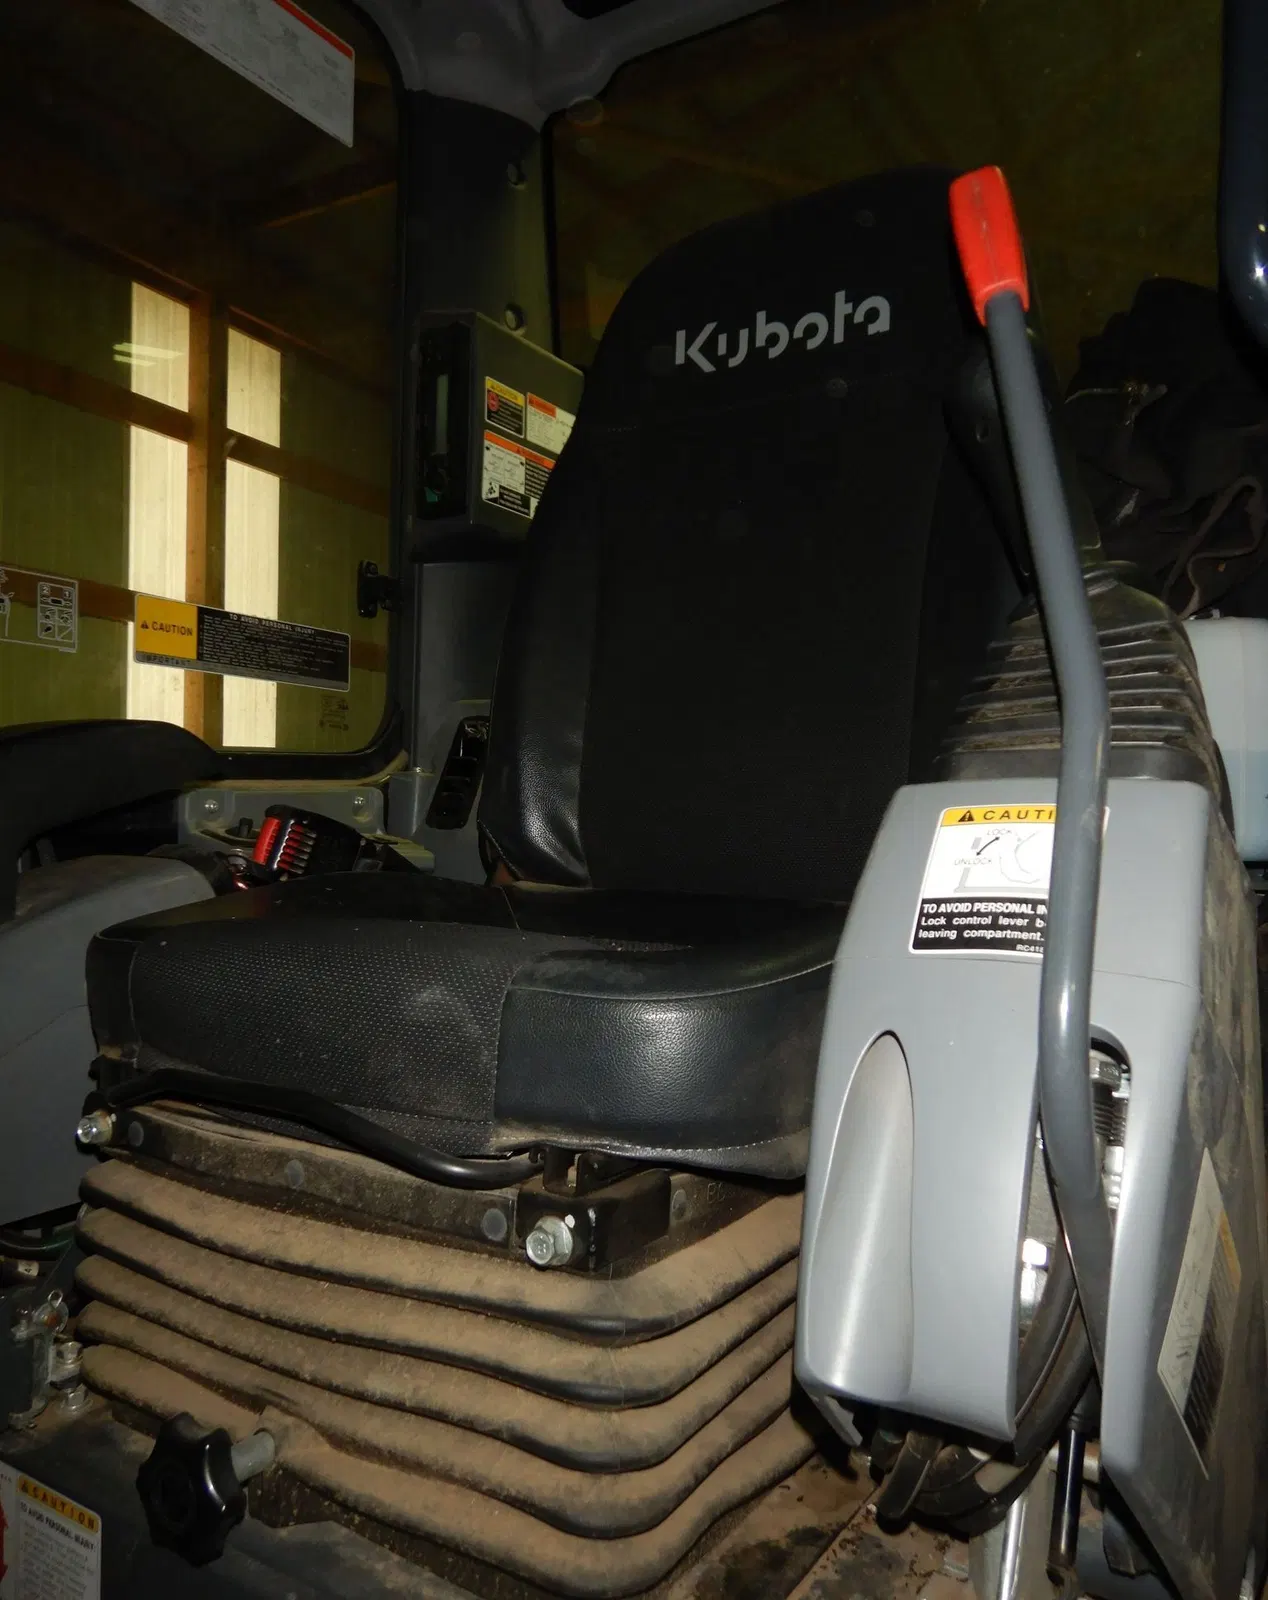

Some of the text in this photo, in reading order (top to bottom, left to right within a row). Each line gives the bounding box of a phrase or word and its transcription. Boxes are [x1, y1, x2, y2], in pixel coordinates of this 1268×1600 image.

[675, 290, 891, 373] Kubota
[151, 621, 193, 637] CAUTION
[229, 613, 315, 635] TO AVOID PERSONAL INJURY
[983, 810, 1054, 821] CAUTI
[986, 828, 1013, 836] LOCK
[954, 857, 993, 866] UNLOCK
[922, 903, 937, 913] TO
[938, 903, 973, 913] AVOID
[973, 903, 1034, 914] PERSONAL
[921, 915, 947, 926] Lock
[952, 915, 992, 926] control
[998, 915, 1029, 927] lever
[918, 929, 1045, 942] leaving compartment.
[32, 1486, 95, 1530] CAUTION
